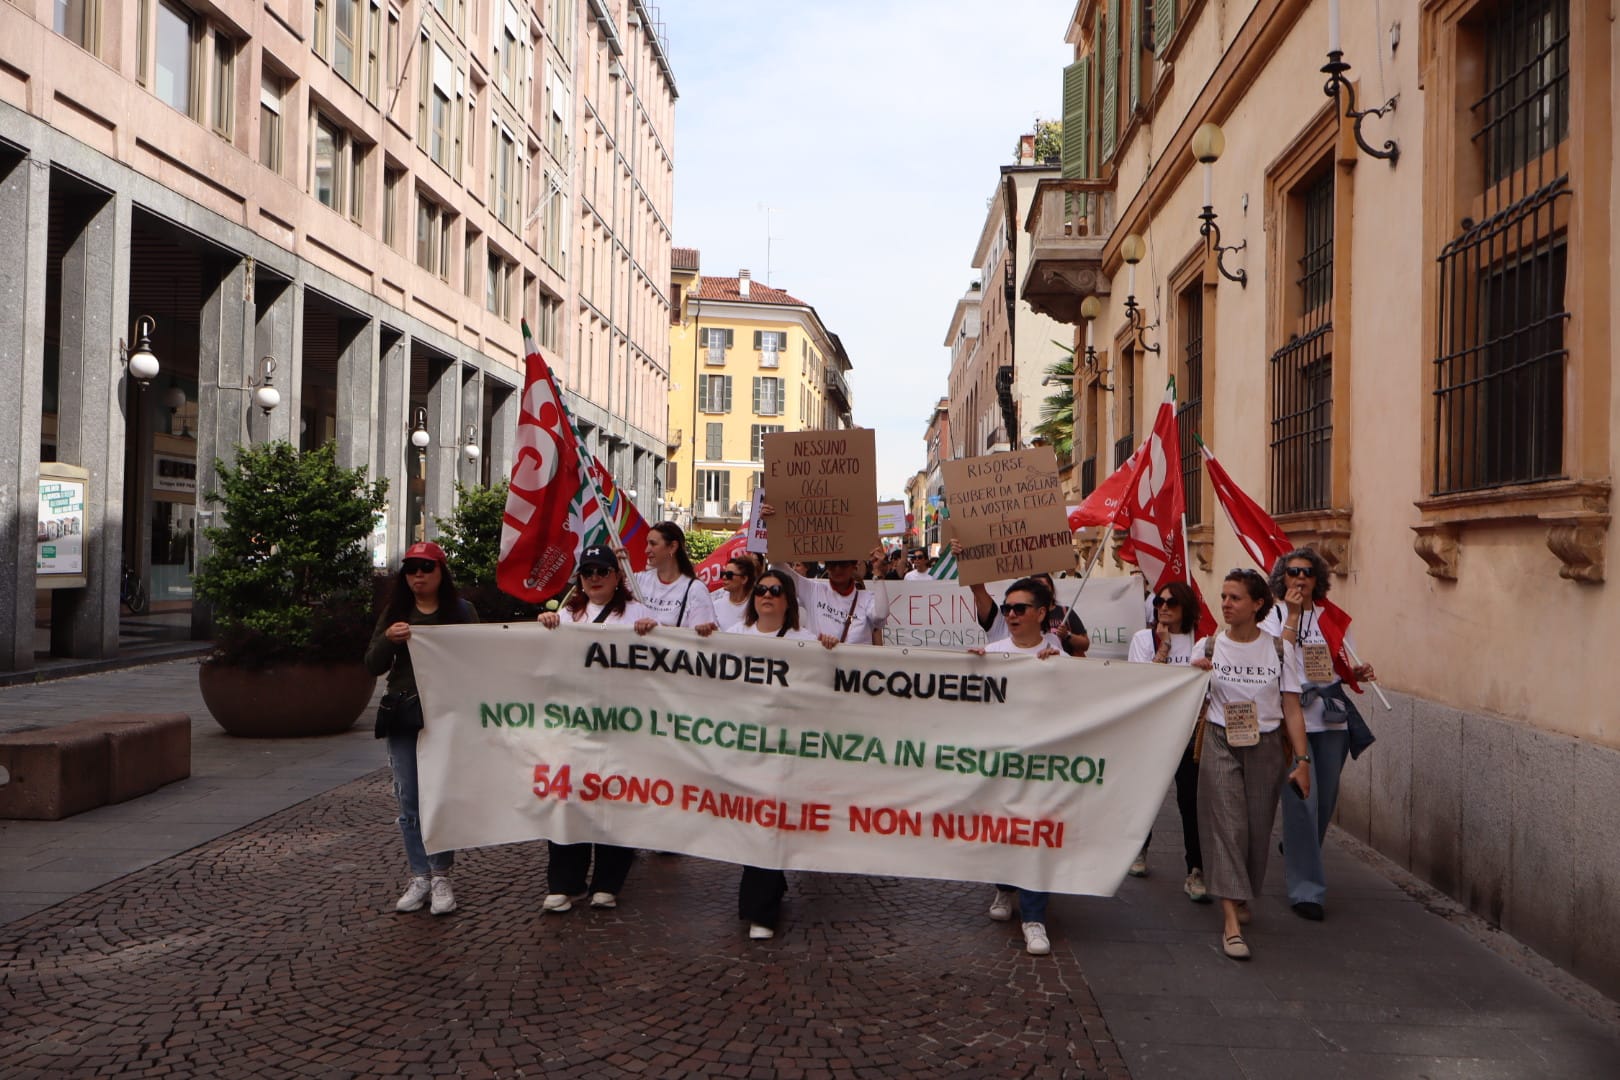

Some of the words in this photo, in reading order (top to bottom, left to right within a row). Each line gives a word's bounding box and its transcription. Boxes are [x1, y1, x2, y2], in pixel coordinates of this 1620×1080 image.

[794, 439, 847, 457] NESSUNO
[786, 460, 811, 477] UNO
[818, 457, 860, 475] SCARTO
[967, 457, 1025, 479] RISORSE
[801, 479, 829, 497] OGGI
[994, 473, 1003, 484] O
[949, 487, 999, 505] ESUBERI
[999, 486, 1013, 497] DA
[785, 498, 850, 516] MCQUEEN
[962, 506, 978, 520] LA
[981, 498, 1021, 516] VOSTRA
[1023, 492, 1057, 508] ETICA
[787, 516, 842, 534] DOMANI
[989, 519, 1027, 538] FINTA
[793, 534, 845, 553] KERING
[961, 542, 997, 561] NOSTRI
[1000, 530, 1073, 556] LICENZIAMENTI
[995, 554, 1034, 574] REALI
[884, 593, 978, 626] KERIN
[882, 627, 986, 647] RESPONSA
[1091, 626, 1128, 644] ALE
[584, 641, 790, 688] ALEXANDER
[833, 667, 1008, 704] MCQUEEN
[480, 701, 535, 729] NOI
[543, 702, 643, 732] SIAMO
[650, 708, 887, 765] L'ECCELLENZA
[893, 739, 926, 768] IN
[935, 744, 1106, 785] ESUBERO!
[532, 764, 573, 800] 54
[579, 772, 674, 807] SONO
[682, 784, 832, 832] FAMIGLIE
[849, 805, 922, 837] NON
[932, 812, 1065, 849] NUMERI
